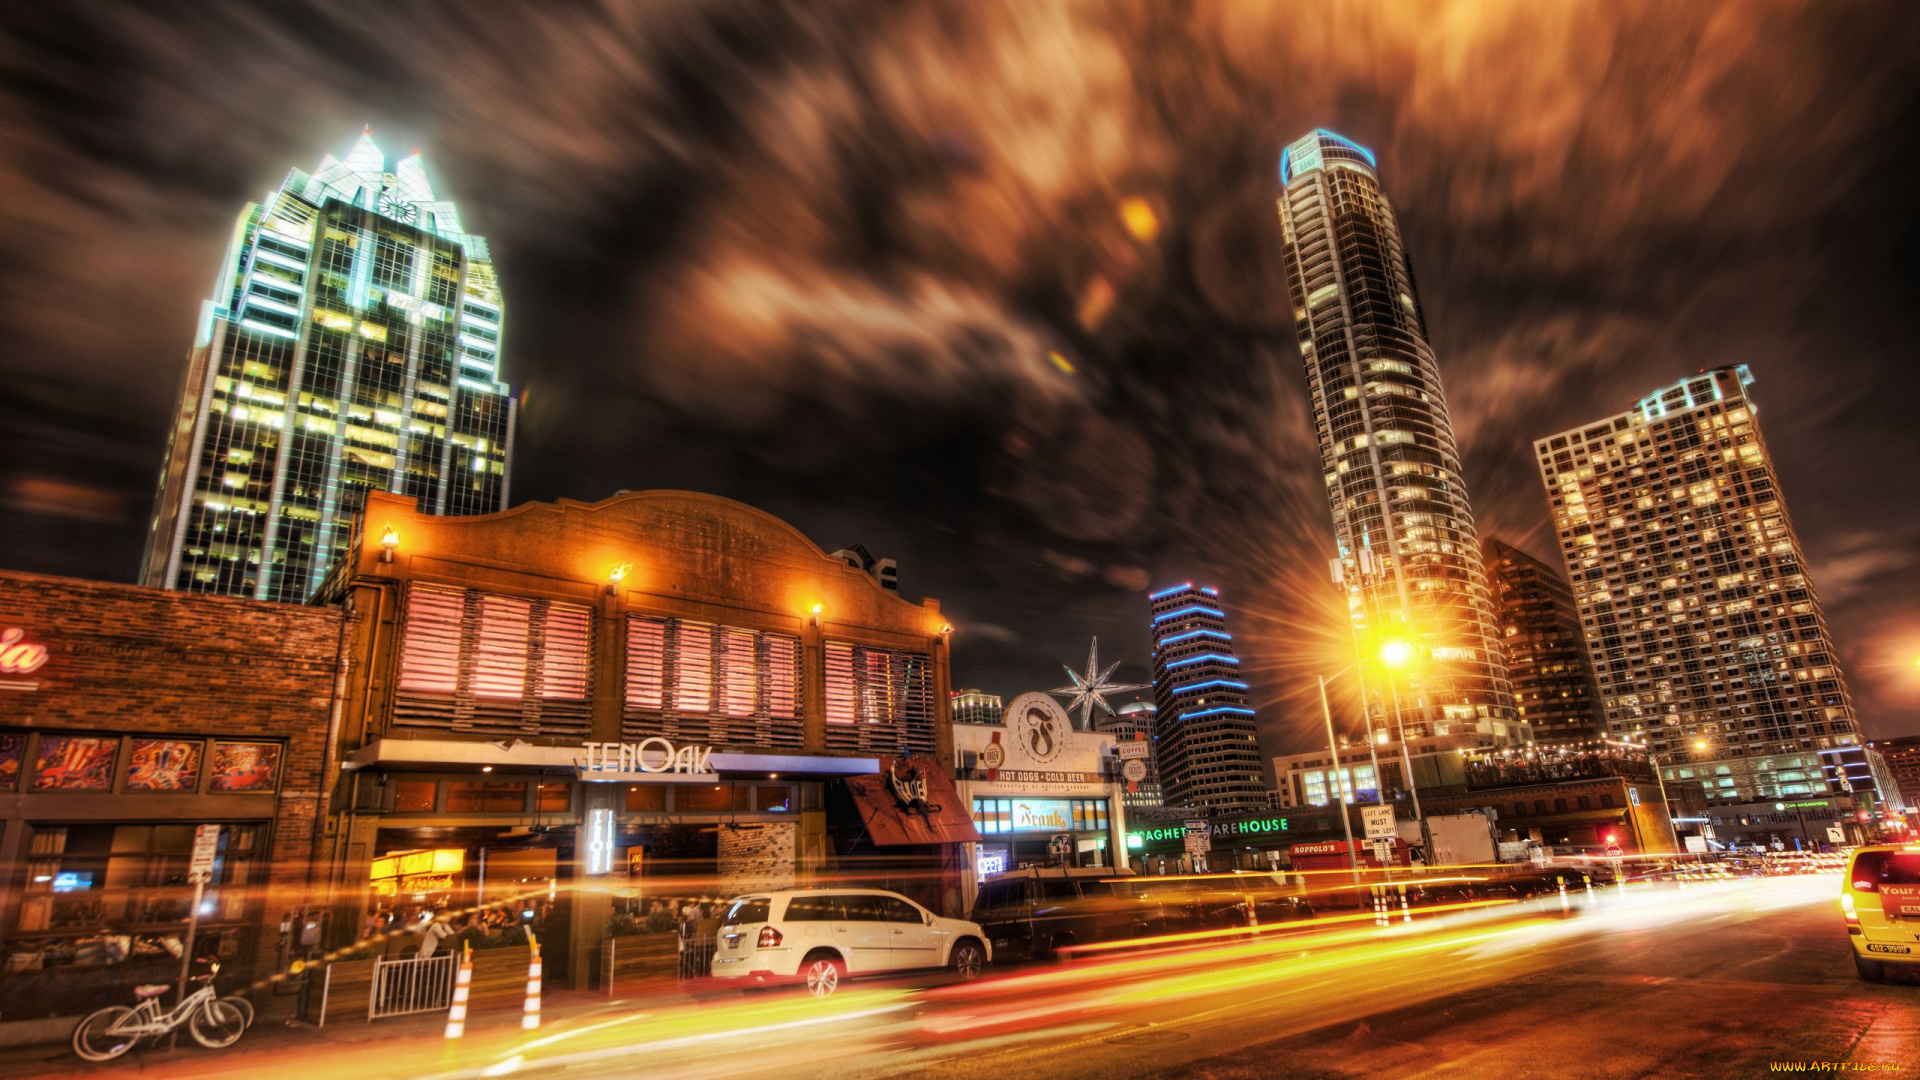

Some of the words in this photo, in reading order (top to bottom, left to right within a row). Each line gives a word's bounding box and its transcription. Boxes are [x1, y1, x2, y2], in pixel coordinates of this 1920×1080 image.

[0, 627, 49, 673] ia
[1000, 771, 1016, 781] HOT
[1018, 772, 1039, 781] DOGS
[1045, 772, 1065, 782] COLD
[1067, 773, 1085, 783] BEER
[1019, 804, 1067, 828] Frank
[1371, 818, 1387, 826] MUST
[1294, 844, 1335, 854] ROPPOLO'S
[1881, 886, 1914, 895] Your
